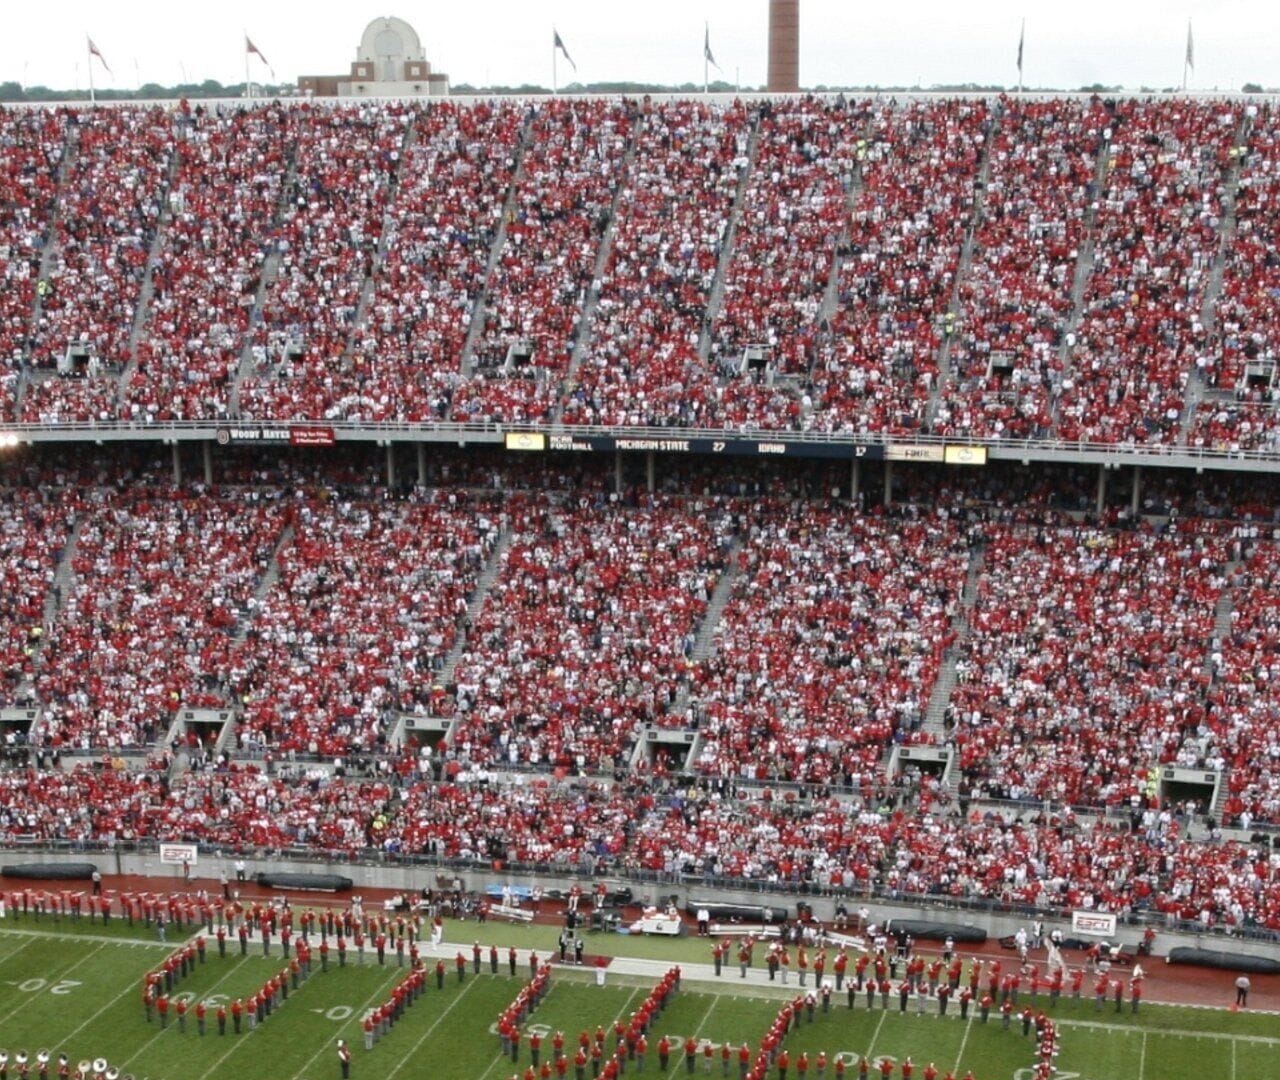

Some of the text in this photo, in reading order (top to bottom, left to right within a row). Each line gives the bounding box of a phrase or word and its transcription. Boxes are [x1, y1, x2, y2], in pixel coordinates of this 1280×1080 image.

[230, 429, 290, 439] WOODY HAYES
[615, 440, 725, 452] MICHIGAN STATE 27
[1076, 917, 1111, 932] ESPN
